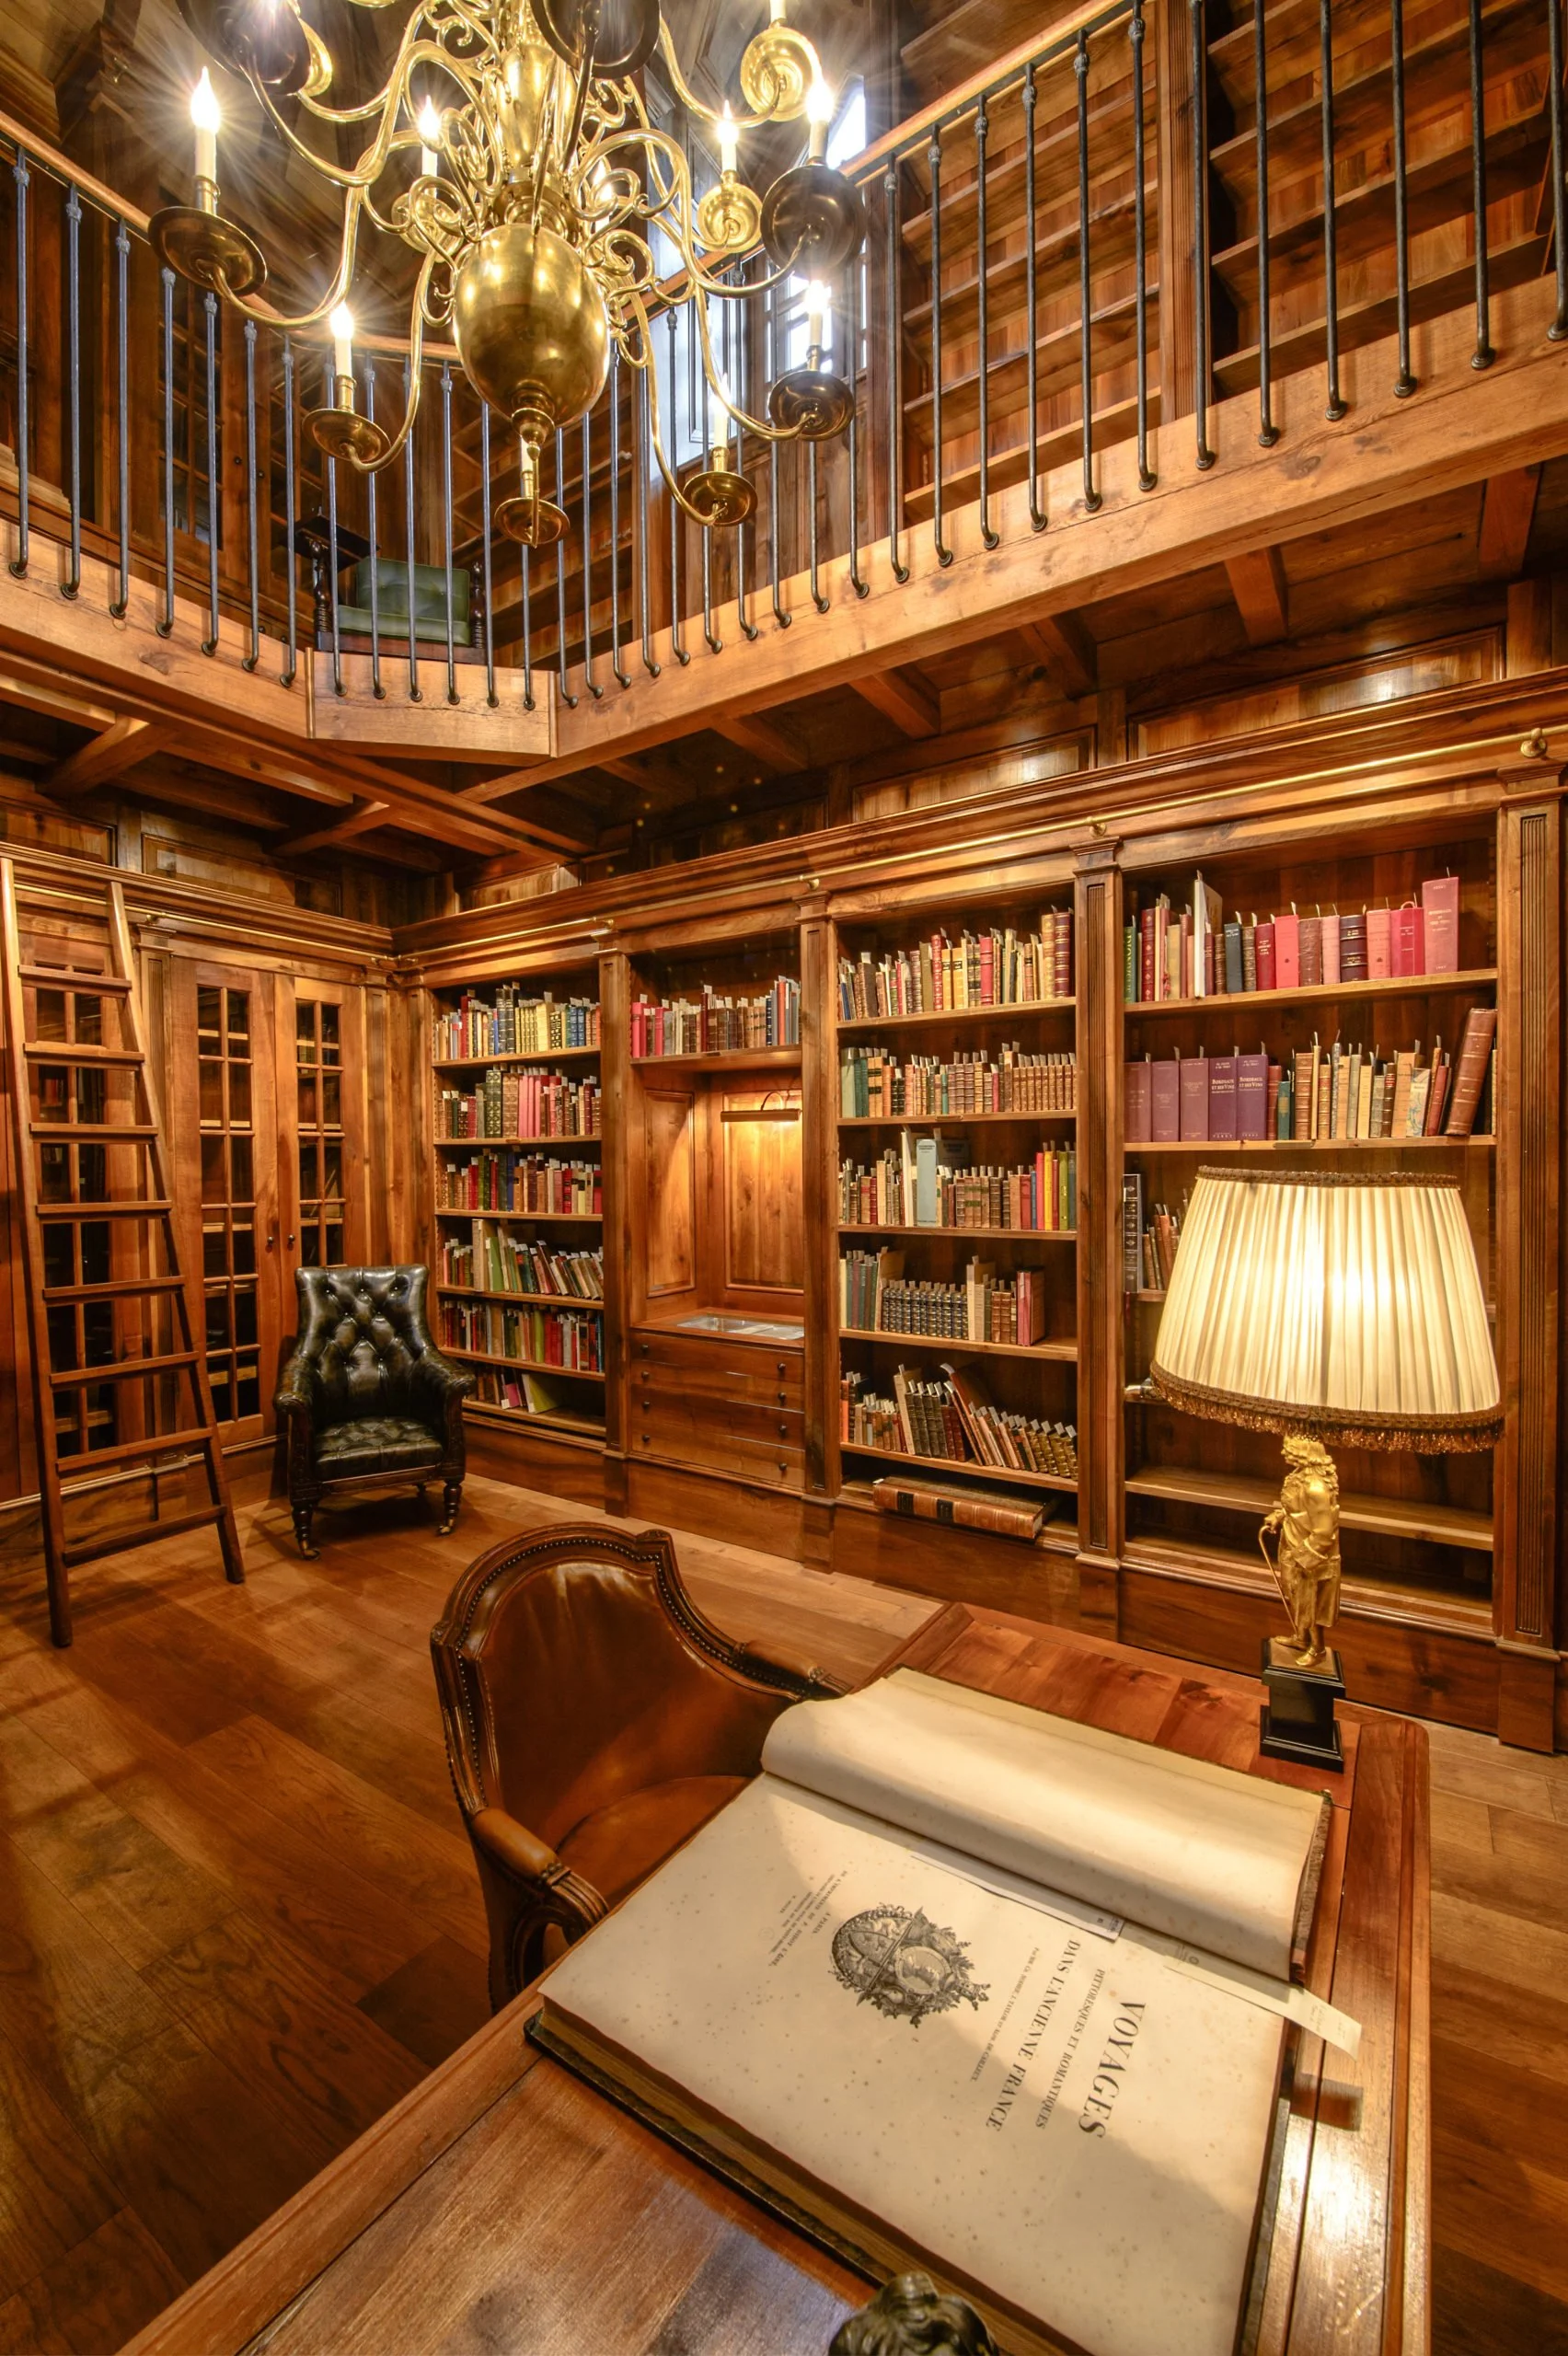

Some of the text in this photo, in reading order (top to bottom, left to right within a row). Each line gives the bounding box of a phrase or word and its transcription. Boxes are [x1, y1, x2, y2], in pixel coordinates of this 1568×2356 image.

[986, 1939, 1081, 2132] DANS L'ANCIENNE FRANCE
[1035, 1969, 1105, 2130] PITTORESQUES ET ROMANTIQUES
[1078, 2002, 1146, 2139] VOYAGES
